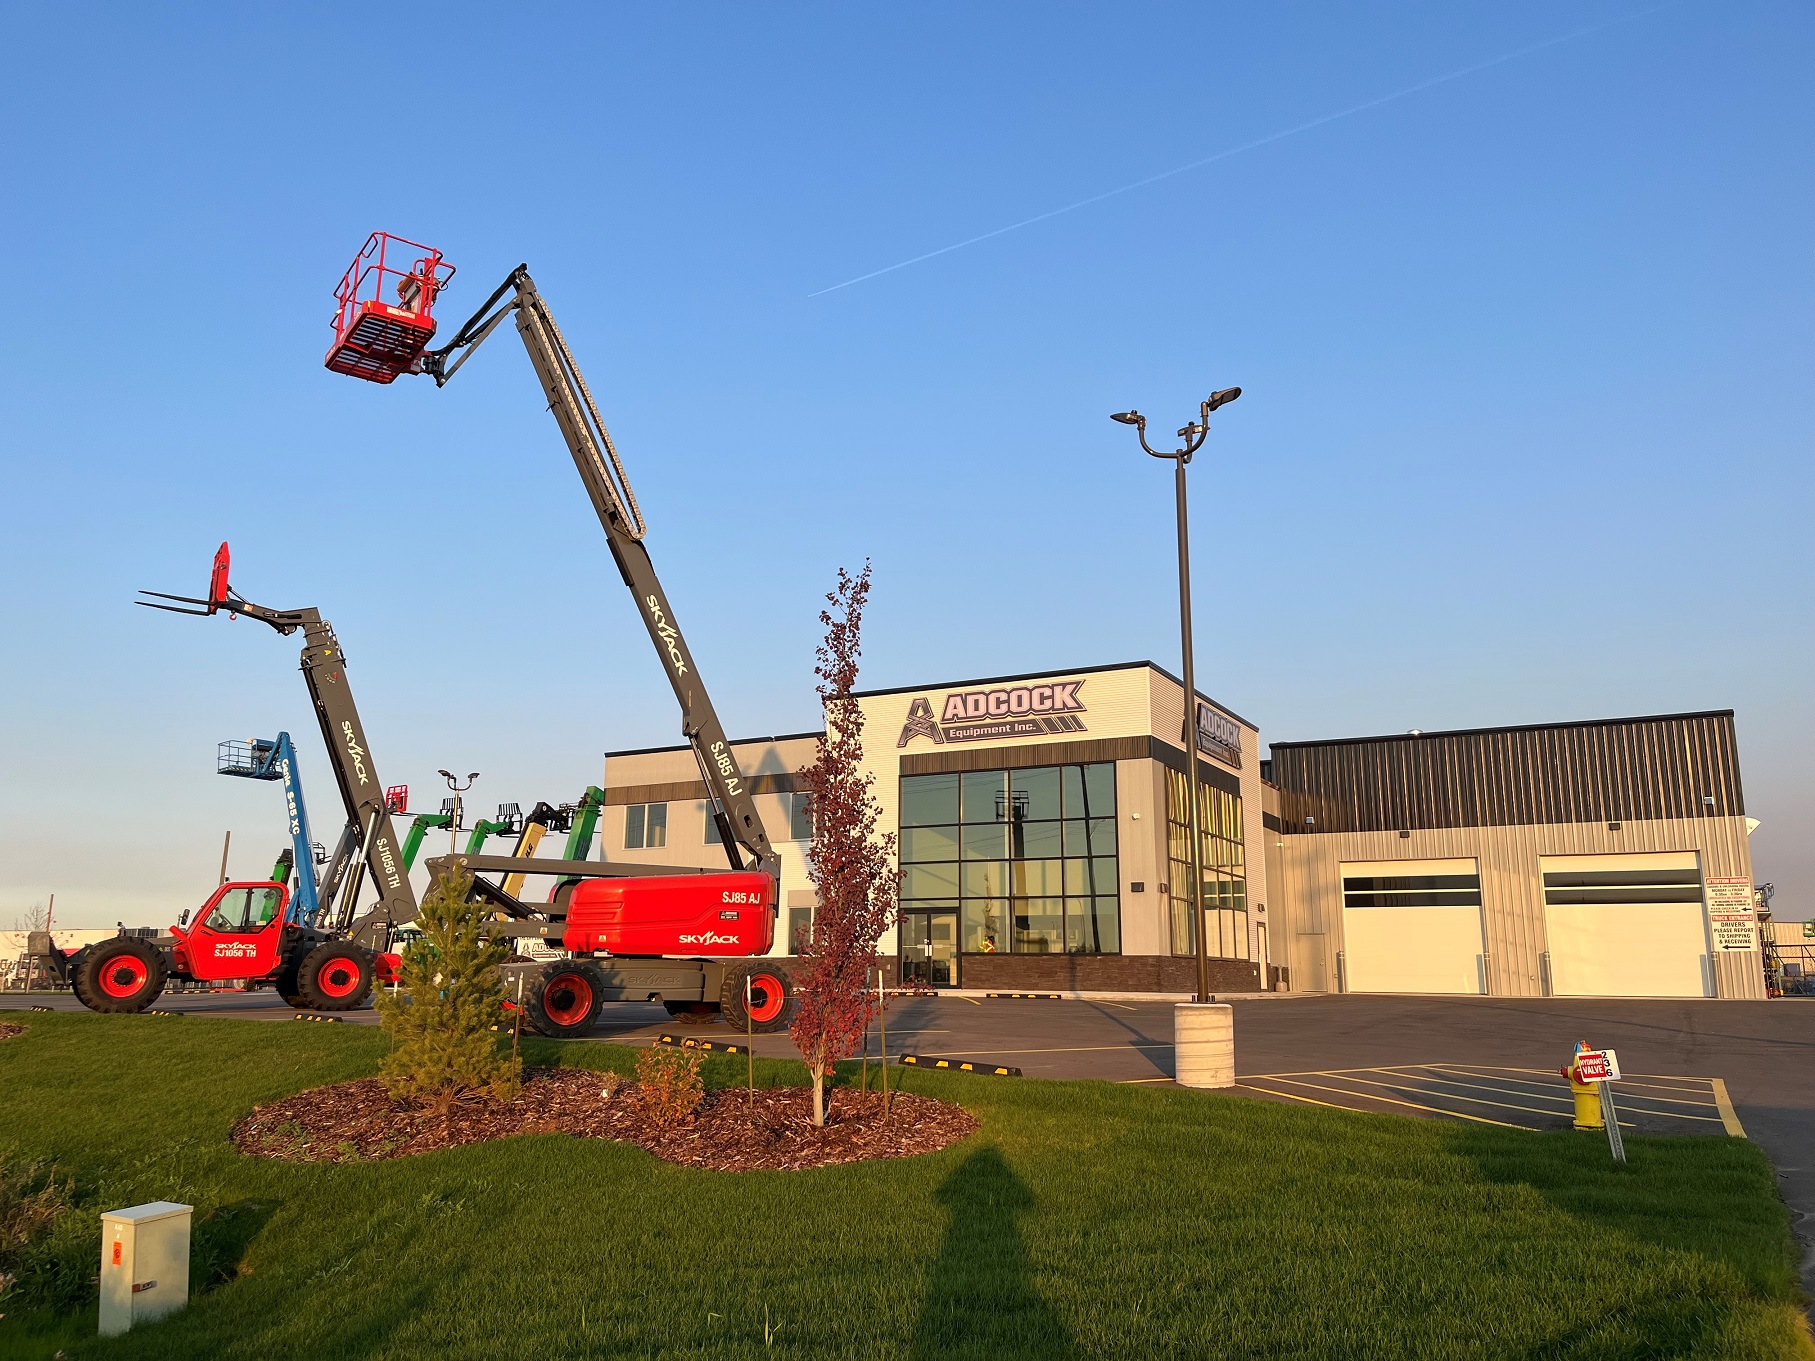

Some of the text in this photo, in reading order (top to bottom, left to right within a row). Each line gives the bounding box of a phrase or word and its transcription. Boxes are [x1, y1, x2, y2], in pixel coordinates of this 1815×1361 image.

[646, 594, 688, 677] SKYJACK
[943, 683, 1077, 720] ADCOCK
[949, 722, 1036, 738] Equipment Inc.
[1200, 705, 1240, 748] ADCOCK
[341, 719, 369, 786] SKYJACK
[711, 740, 743, 797] SJ85 AJ
[282, 758, 291, 788] Genie
[290, 818, 300, 835] XC
[376, 838, 401, 889] SJ1056 TH
[722, 891, 760, 904] SJ85 AJ
[215, 941, 257, 949] SKYJACK
[678, 930, 740, 946] SKYJACK
[214, 949, 244, 957] SJ1056
[628, 973, 681, 986] SKYJACK
[1580, 1057, 1603, 1065] HYDRANT
[1601, 1051, 1608, 1059] 2
[1582, 1065, 1604, 1074] VALVE
[1603, 1059, 1611, 1067] 3
[1606, 1069, 1613, 1077] 6
